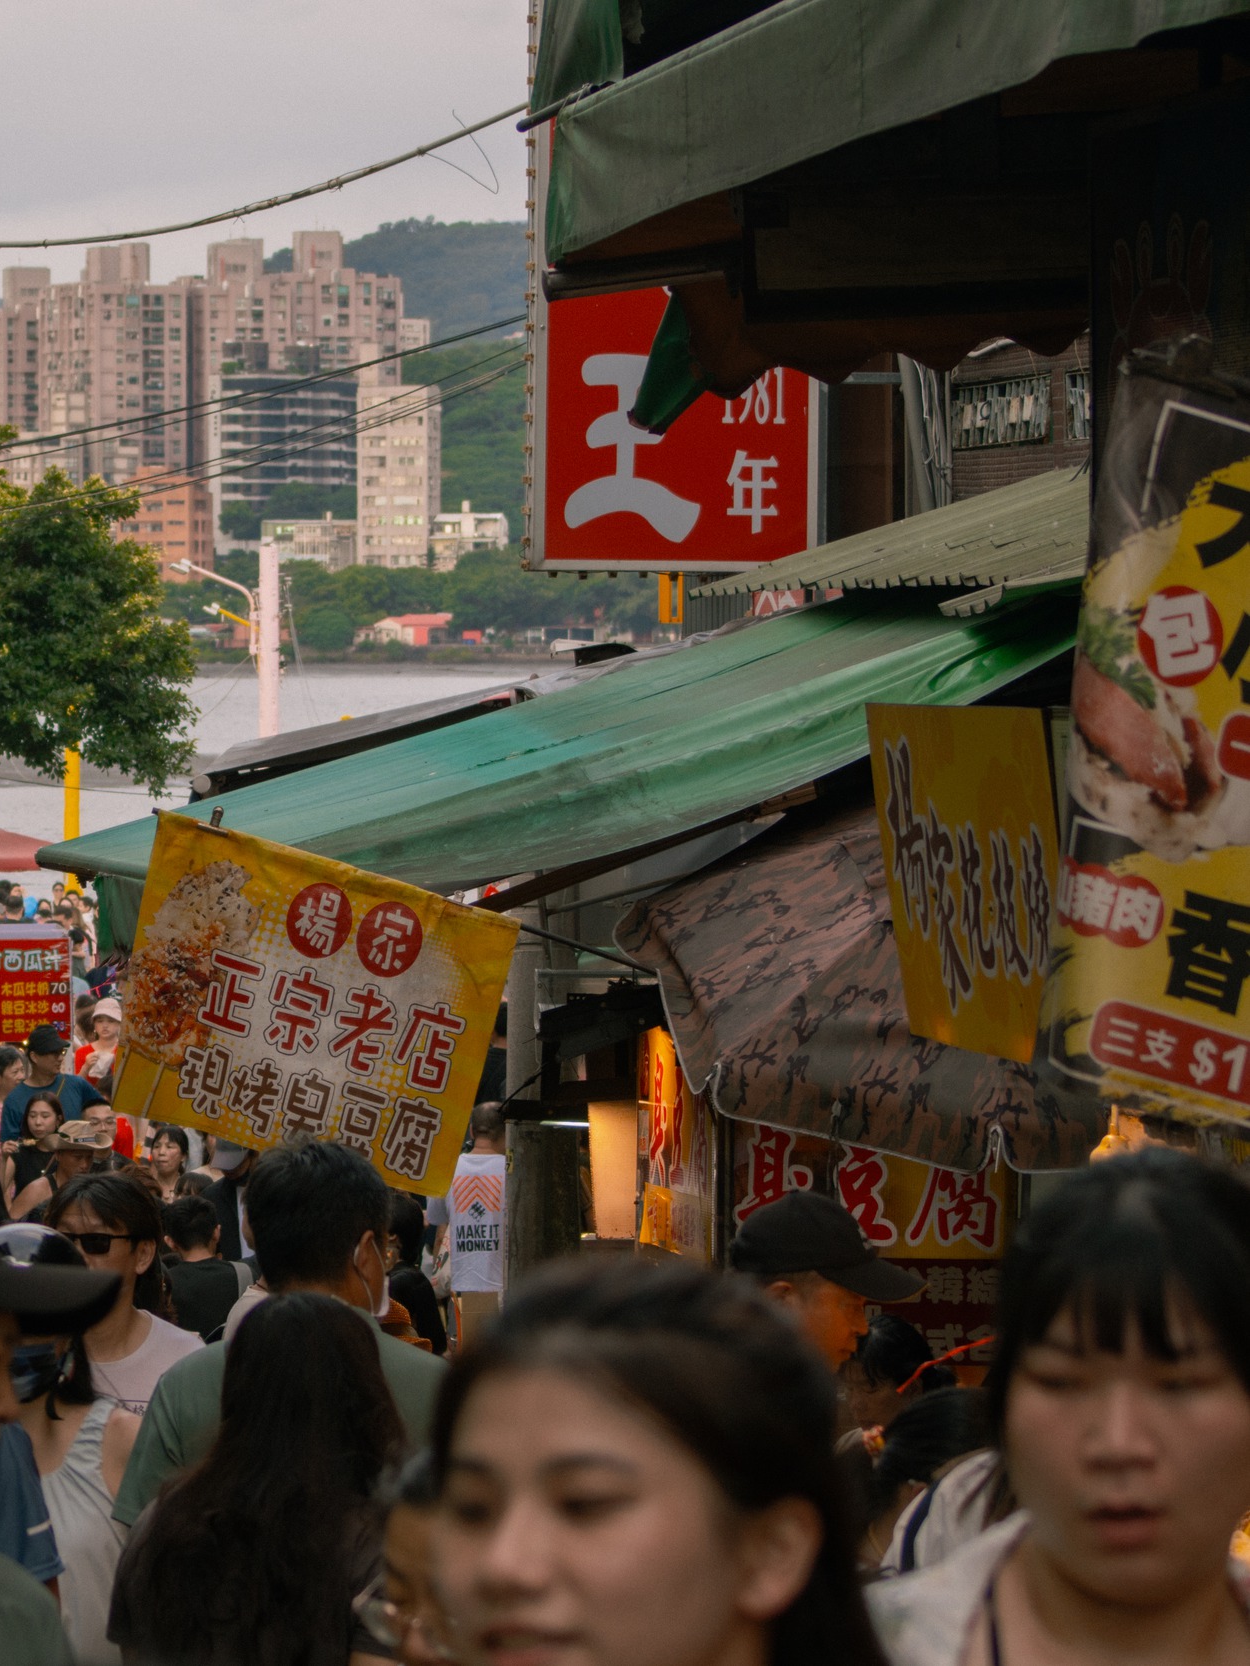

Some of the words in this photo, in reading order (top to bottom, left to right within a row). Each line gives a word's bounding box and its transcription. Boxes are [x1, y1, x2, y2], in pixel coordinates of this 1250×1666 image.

[725, 449, 779, 534] 年
[1140, 592, 1216, 678] 包
[1166, 889, 1250, 1016] 香
[1, 982, 49, 997] 木瓜牛奶
[50, 982, 68, 994] 70
[51, 1002, 66, 1013] 60
[197, 949, 467, 1093] 正宗老店
[1100, 1017, 1179, 1070] 三支
[178, 1044, 443, 1181] 現烤臭豆腐
[456, 1224, 487, 1239] MAKE
[489, 1224, 500, 1239] IT
[456, 1239, 500, 1252] MONKEY
